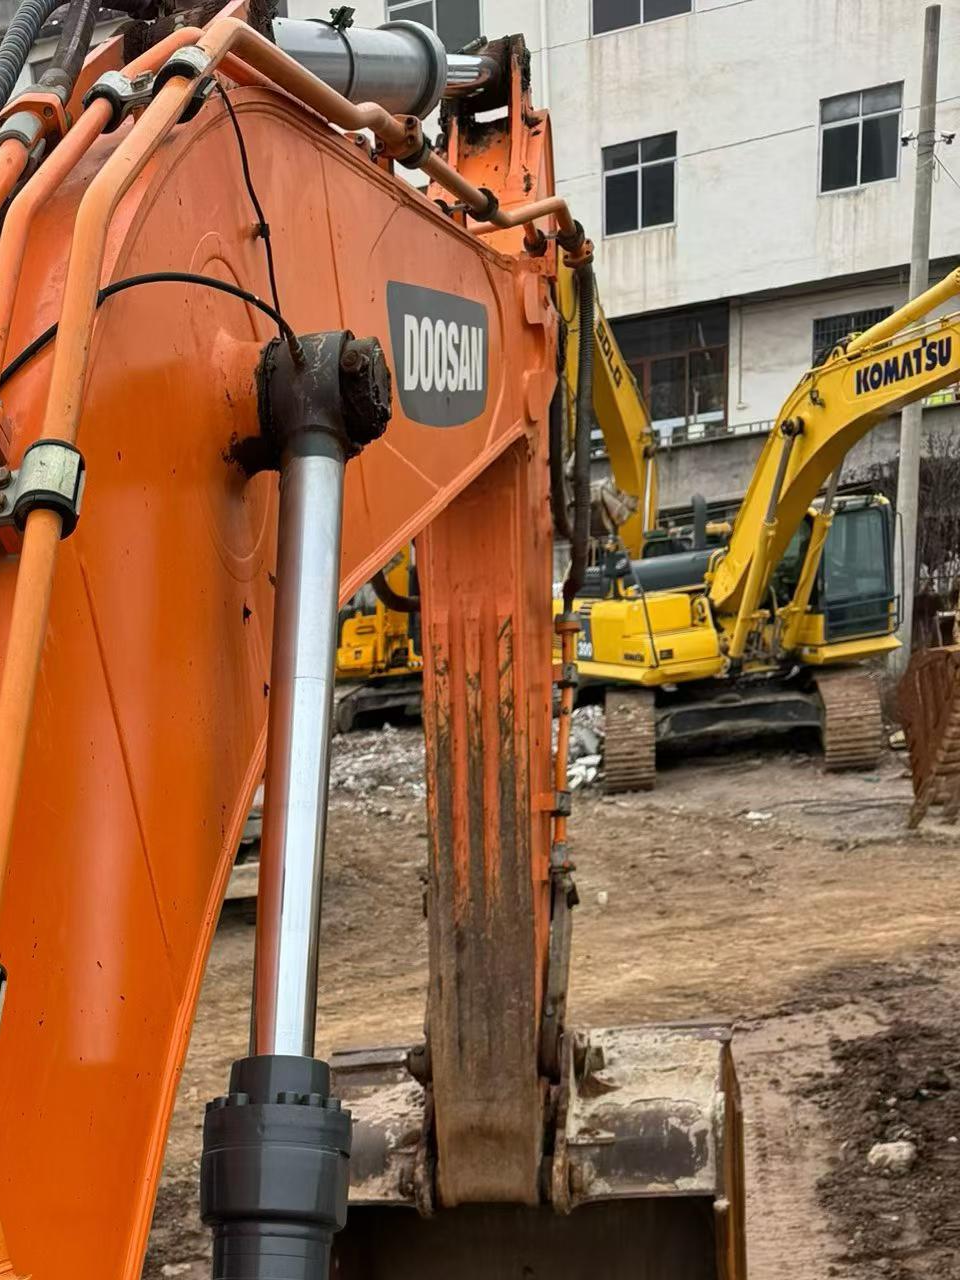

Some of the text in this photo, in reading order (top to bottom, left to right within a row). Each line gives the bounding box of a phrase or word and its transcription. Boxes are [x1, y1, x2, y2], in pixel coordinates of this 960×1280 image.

[404, 313, 483, 392] DOOSAN
[596, 321, 623, 388] SDLG
[856, 337, 952, 395] KOMATSU
